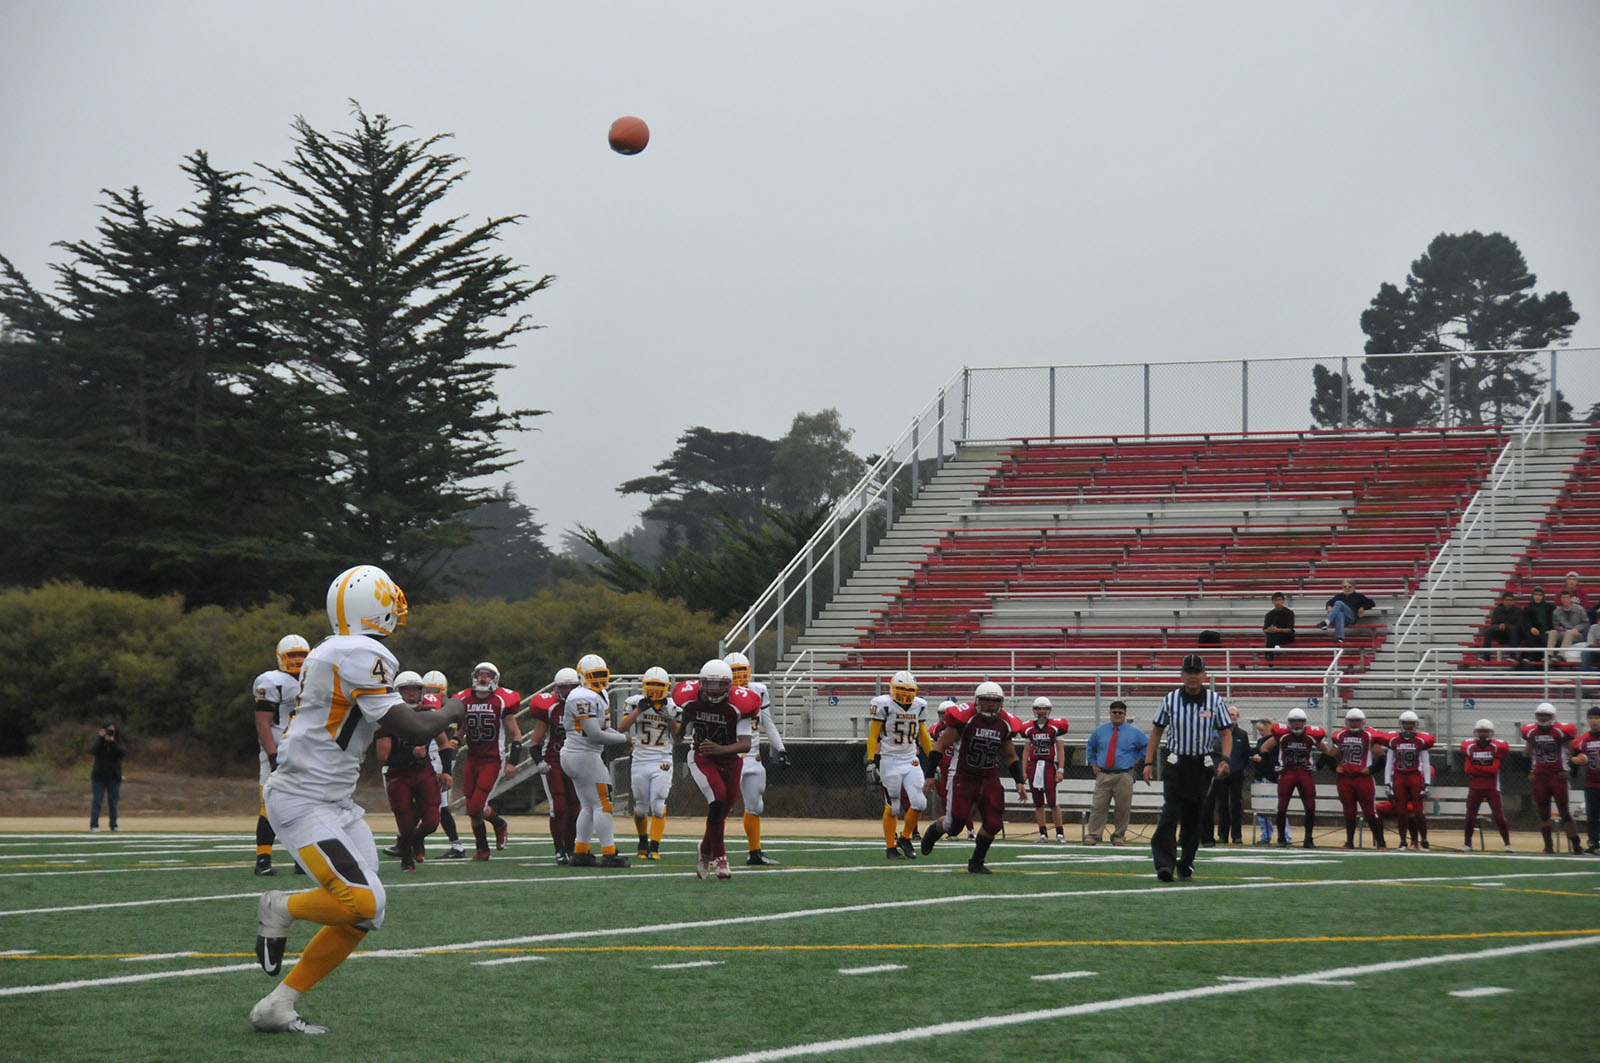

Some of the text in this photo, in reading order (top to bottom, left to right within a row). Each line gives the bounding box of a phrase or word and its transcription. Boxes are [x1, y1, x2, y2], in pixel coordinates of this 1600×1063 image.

[371, 657, 389, 684] 4
[467, 704, 494, 712] LOWELL
[696, 711, 728, 725] LOWELL
[466, 713, 496, 741] 85
[641, 720, 667, 746] 52
[894, 721, 917, 744] 50
[975, 728, 1001, 741] LOWELL
